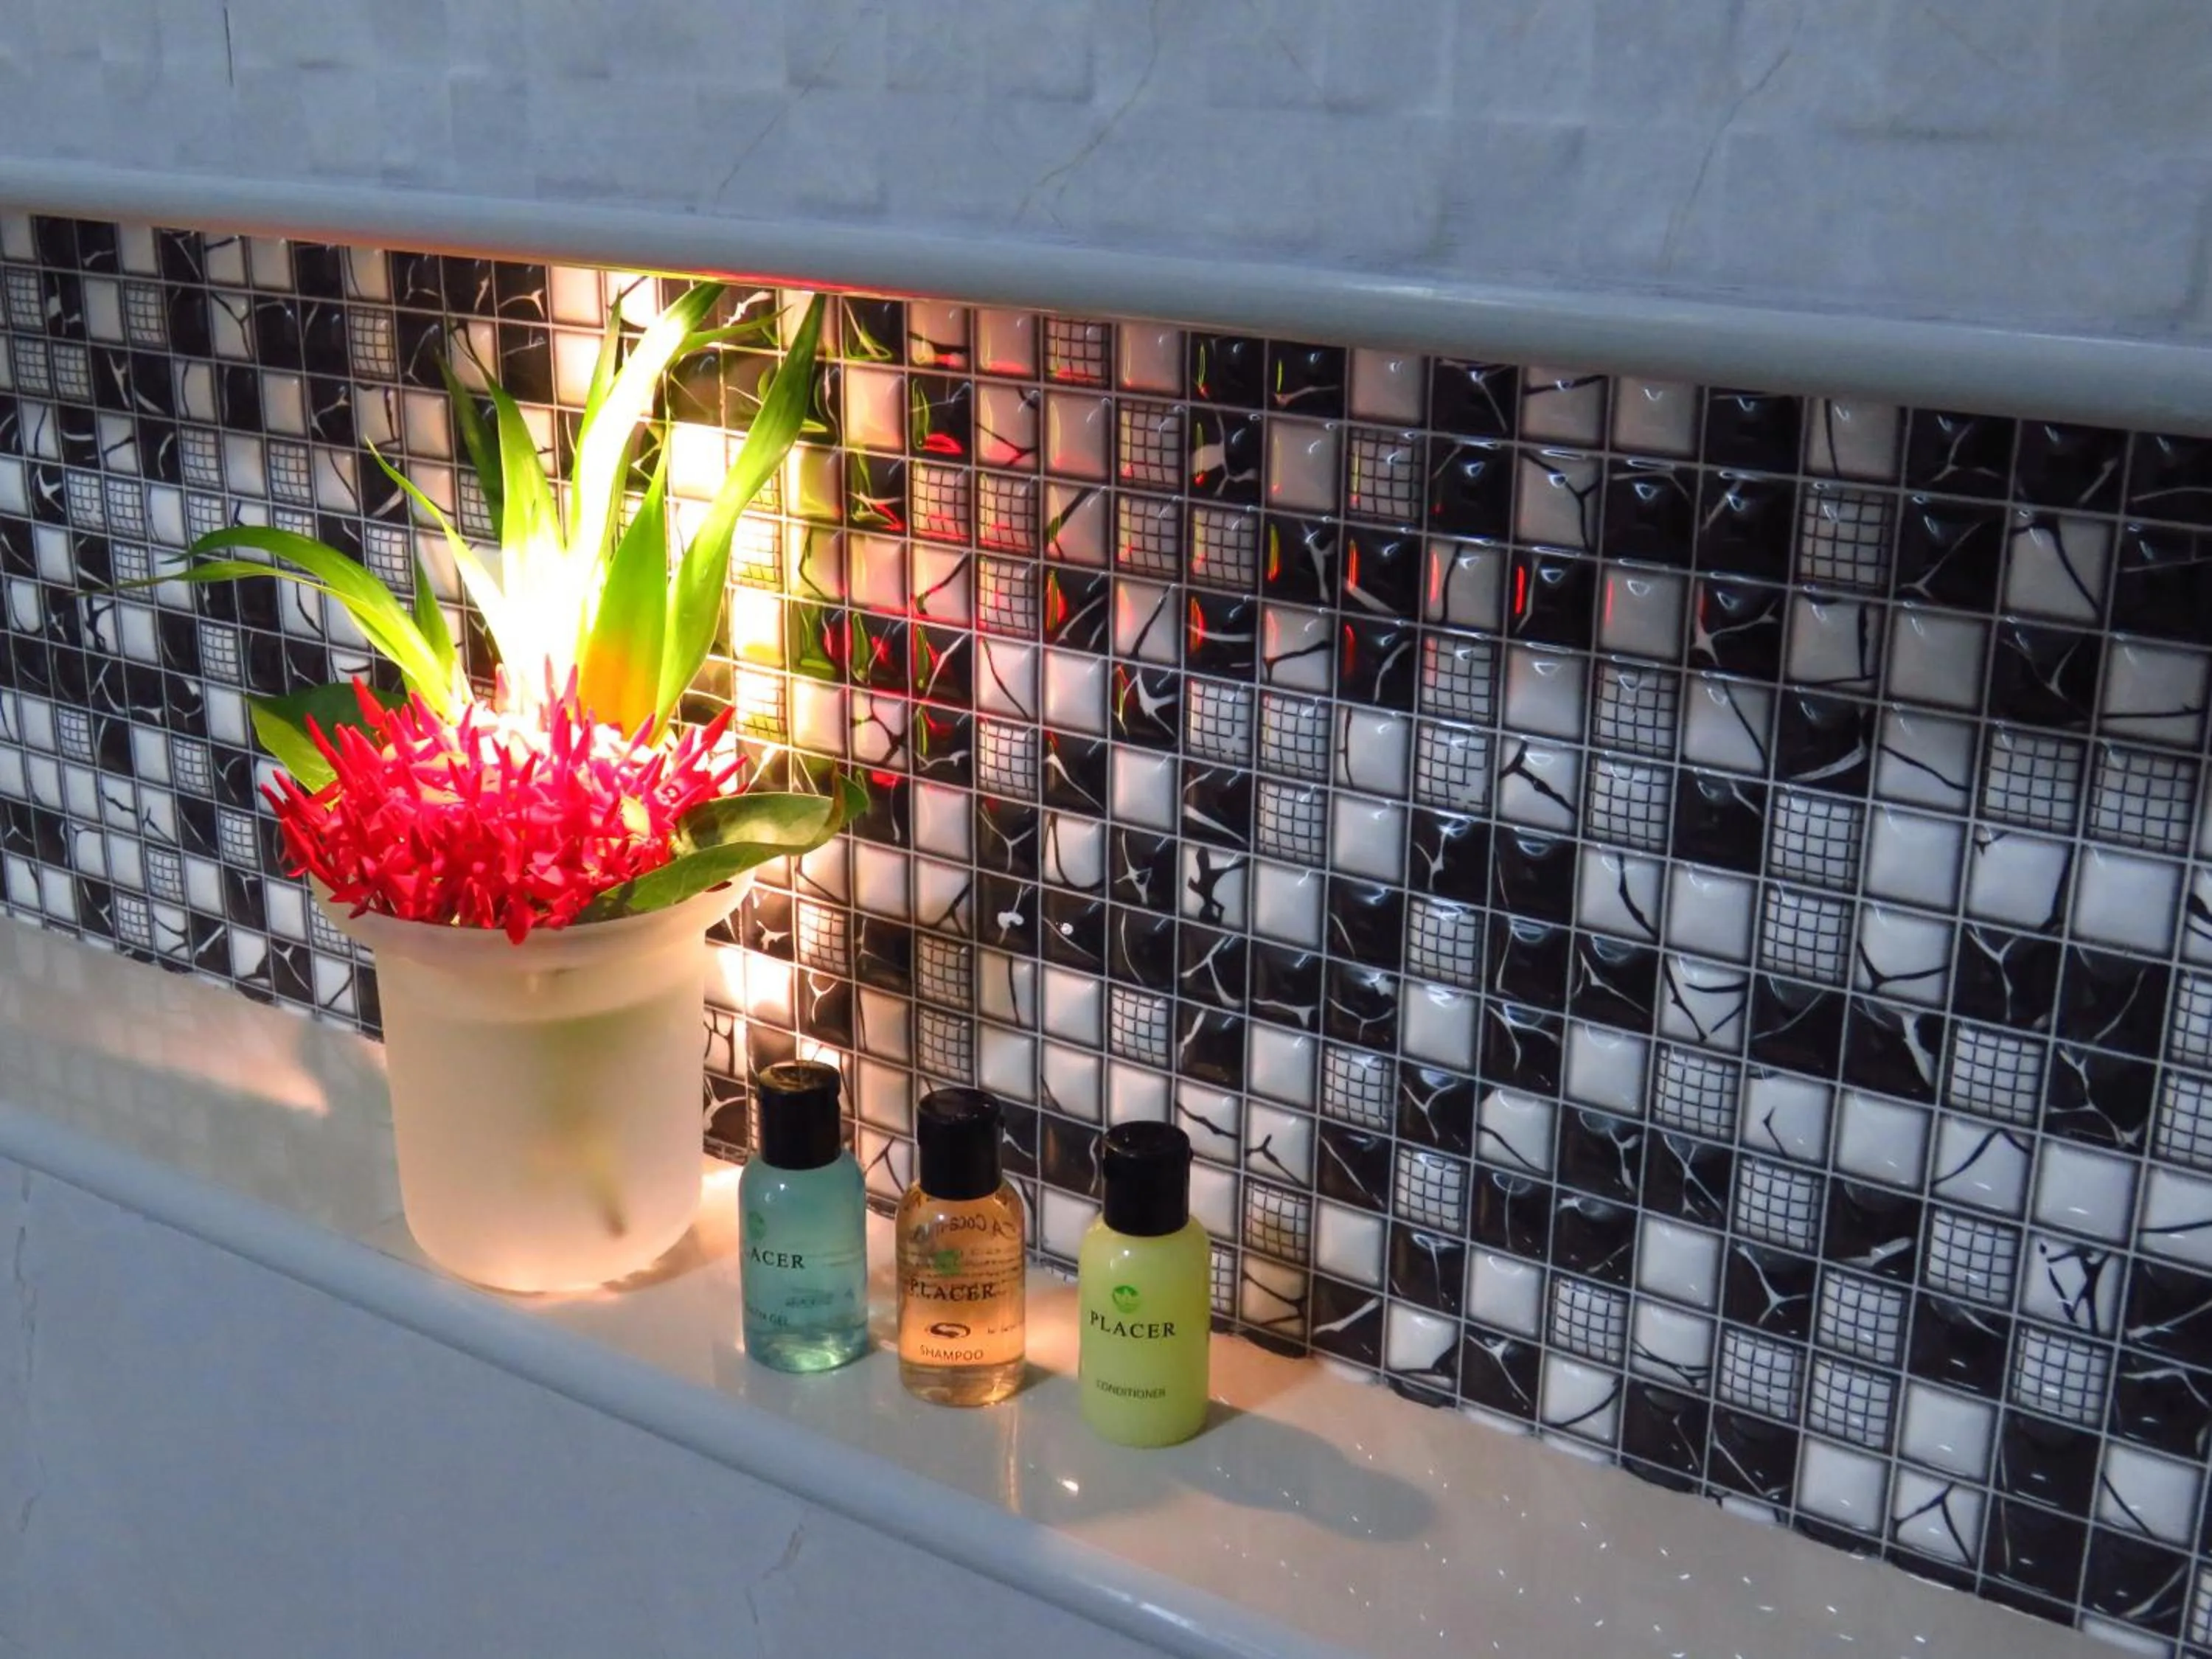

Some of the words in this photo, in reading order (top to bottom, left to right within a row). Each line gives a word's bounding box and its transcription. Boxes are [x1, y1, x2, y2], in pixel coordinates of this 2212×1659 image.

[745, 1246, 806, 1269] ACER
[910, 1277, 996, 1301] PLACER
[1091, 1310, 1176, 1339] PLACER
[919, 1344, 984, 1361] SHAMPOO
[1096, 1380, 1166, 1399] CONDITIONER
